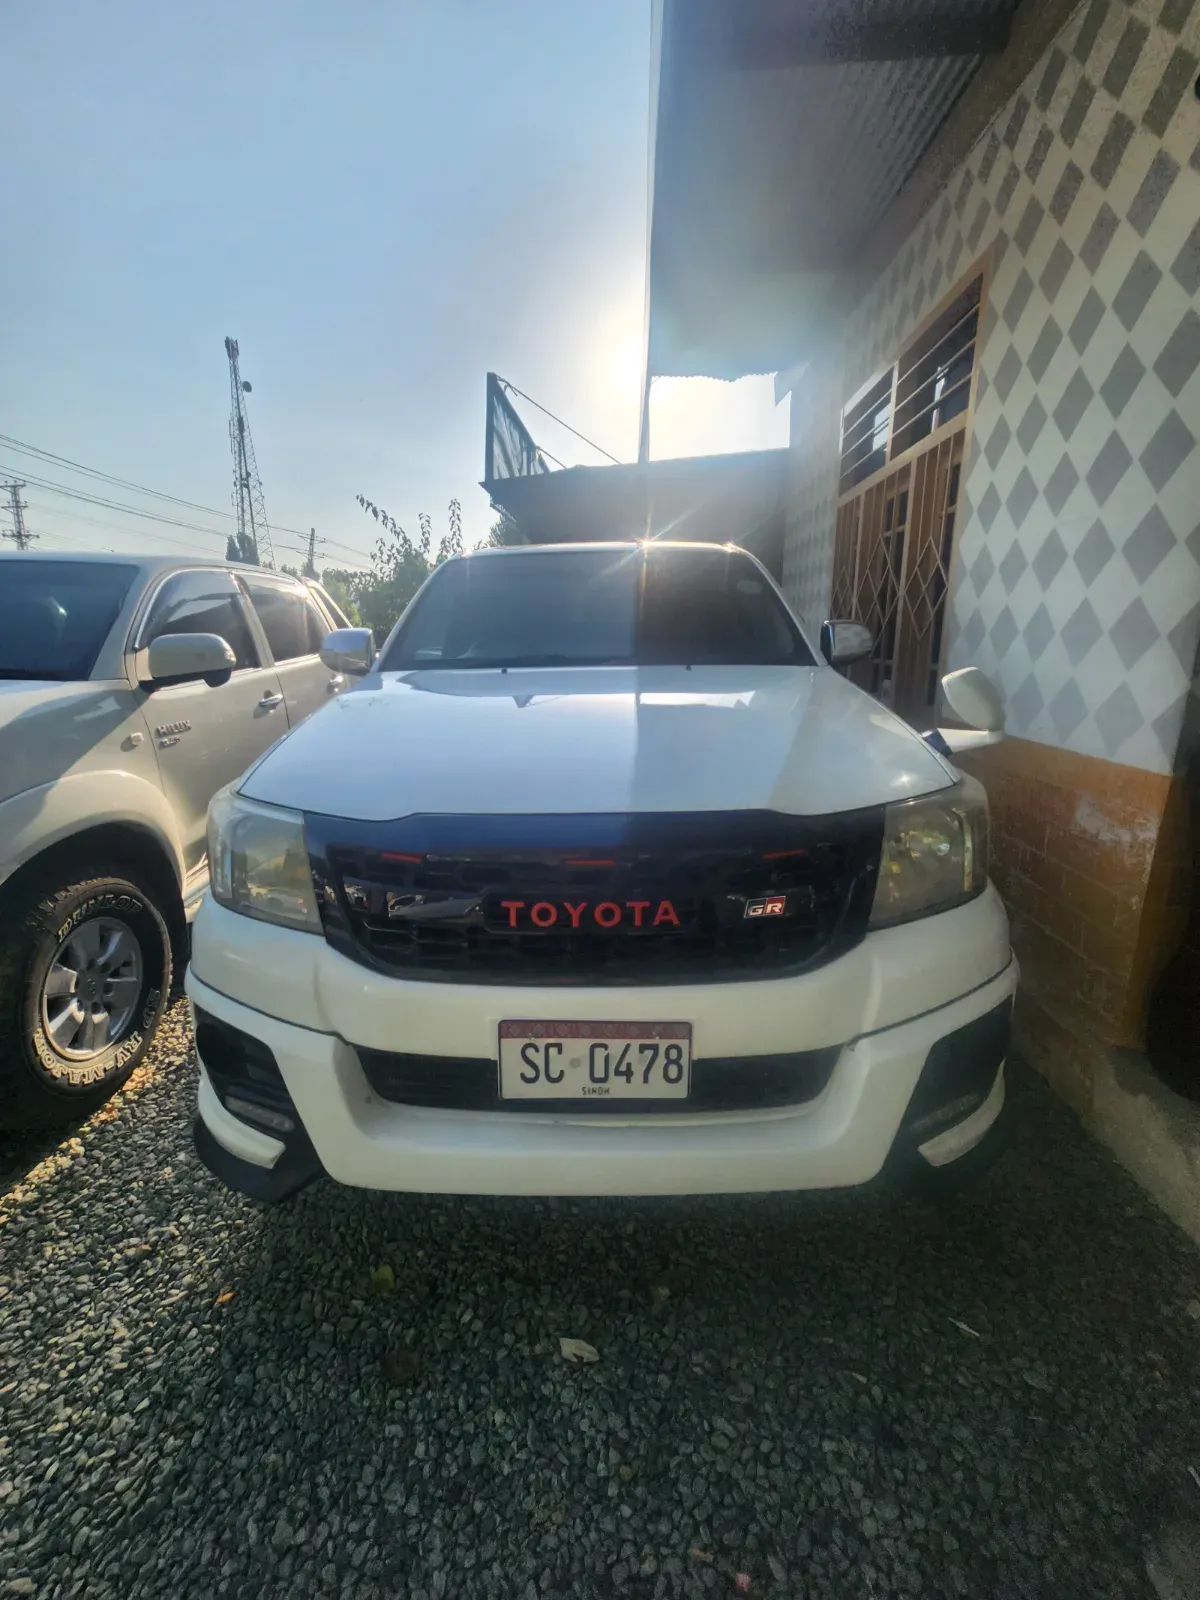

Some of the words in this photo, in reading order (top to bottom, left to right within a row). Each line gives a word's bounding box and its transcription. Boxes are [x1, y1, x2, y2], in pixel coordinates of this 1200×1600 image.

[58, 894, 143, 943] DUNLOP
[500, 900, 680, 928] TOYOTA
[748, 902, 782, 916] GR
[520, 1043, 565, 1084] SC
[589, 1043, 683, 1084] 0478
[581, 1086, 611, 1096] SINDH
